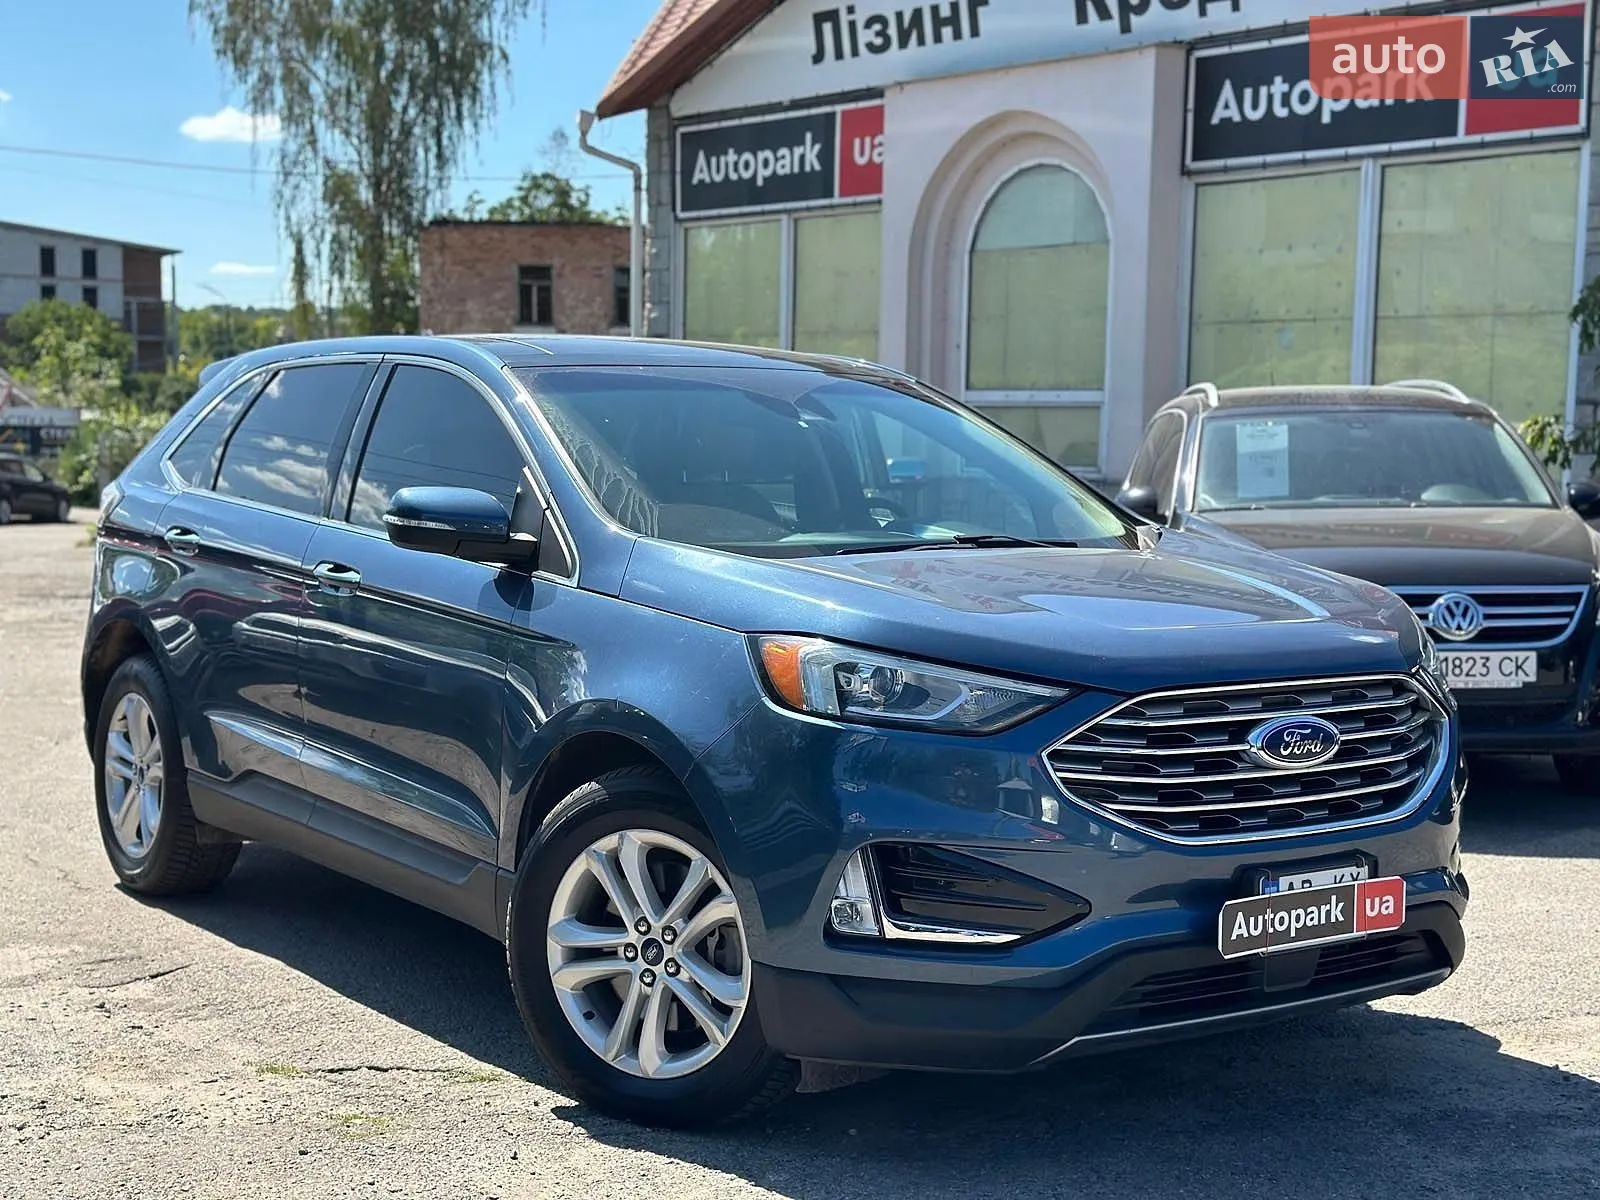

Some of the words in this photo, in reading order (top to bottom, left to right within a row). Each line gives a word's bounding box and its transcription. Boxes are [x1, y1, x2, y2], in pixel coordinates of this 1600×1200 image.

[811, 0, 990, 66] Лізинг
[691, 131, 822, 187] Autopark
[1440, 656, 1490, 677] 1823
[1499, 656, 1530, 677] CK
[1280, 728, 1324, 756] Ford
[1230, 895, 1345, 940] Autopark
[1365, 894, 1395, 917] ua
